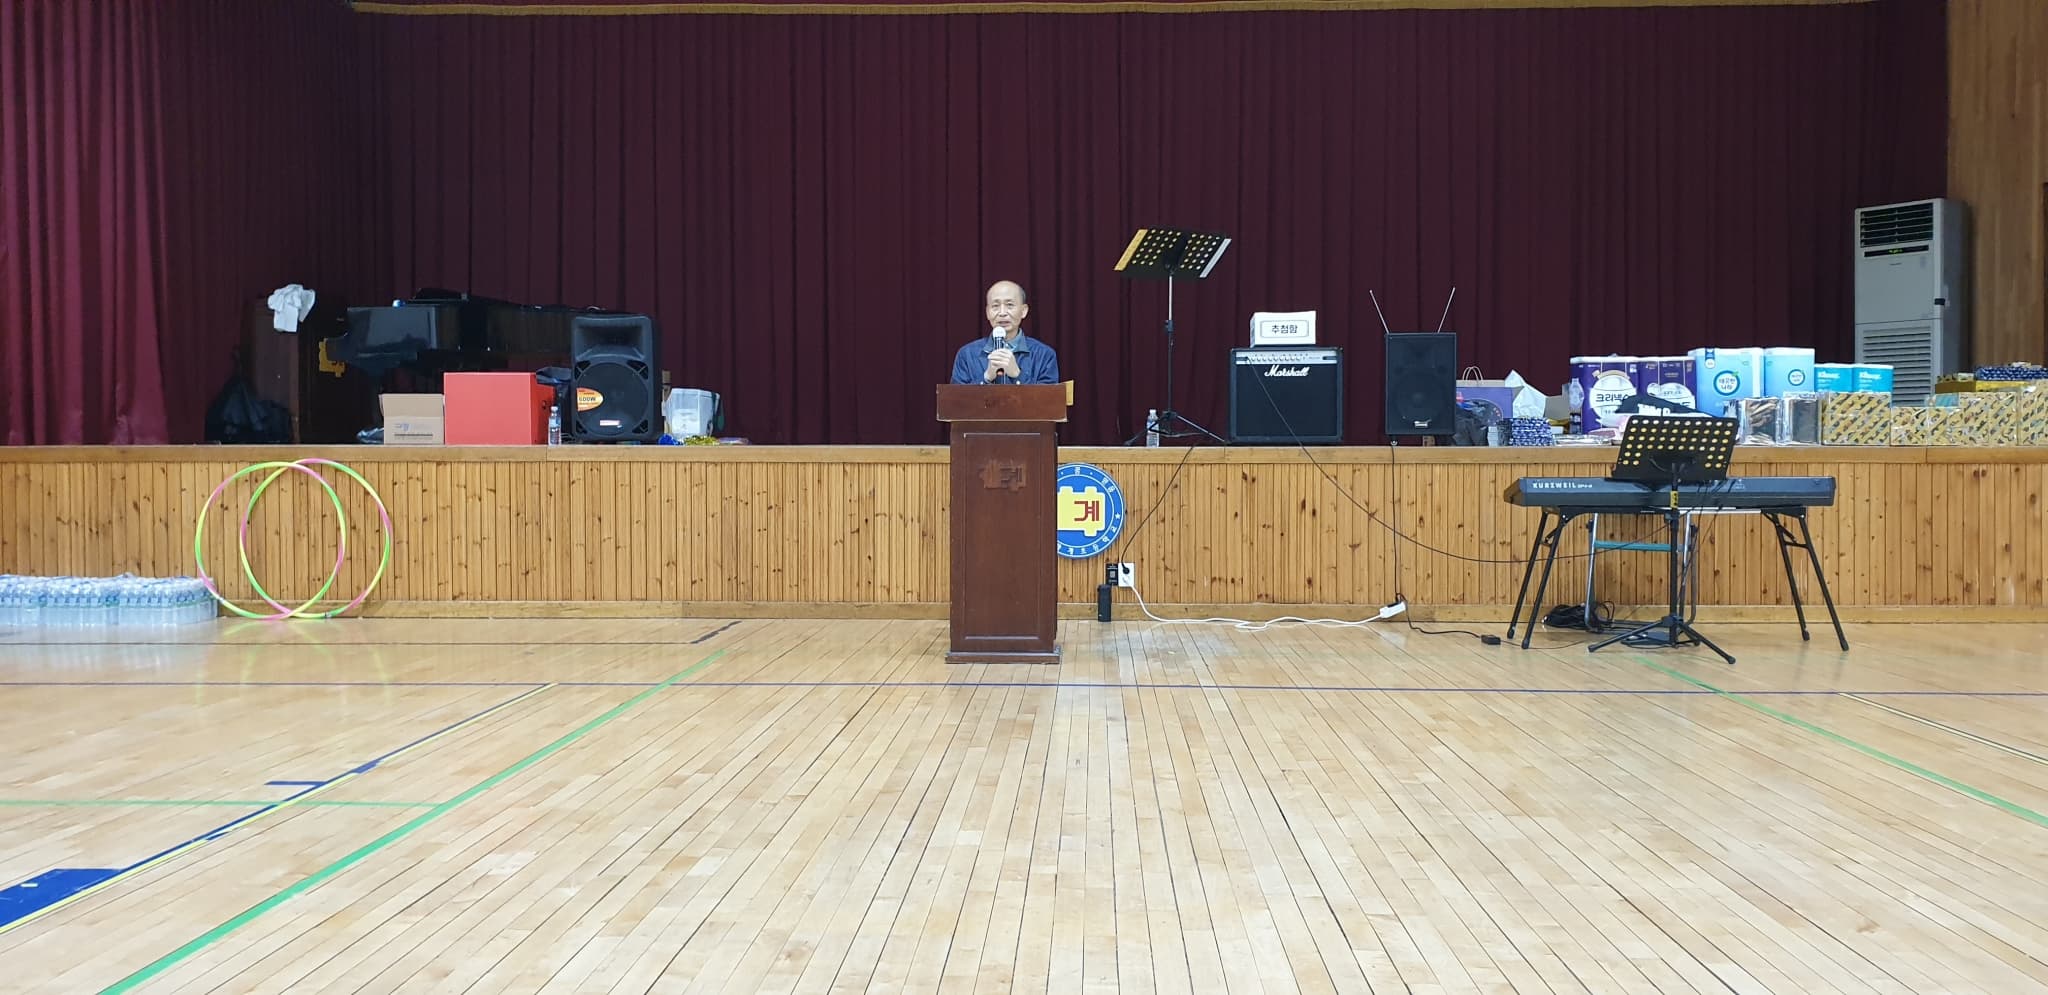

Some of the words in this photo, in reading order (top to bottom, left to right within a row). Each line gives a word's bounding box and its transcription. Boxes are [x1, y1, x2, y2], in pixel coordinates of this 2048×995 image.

[1272, 324, 1298, 334] 추첨함
[1264, 364, 1309, 377] Marshall
[1074, 500, 1100, 521] 계
